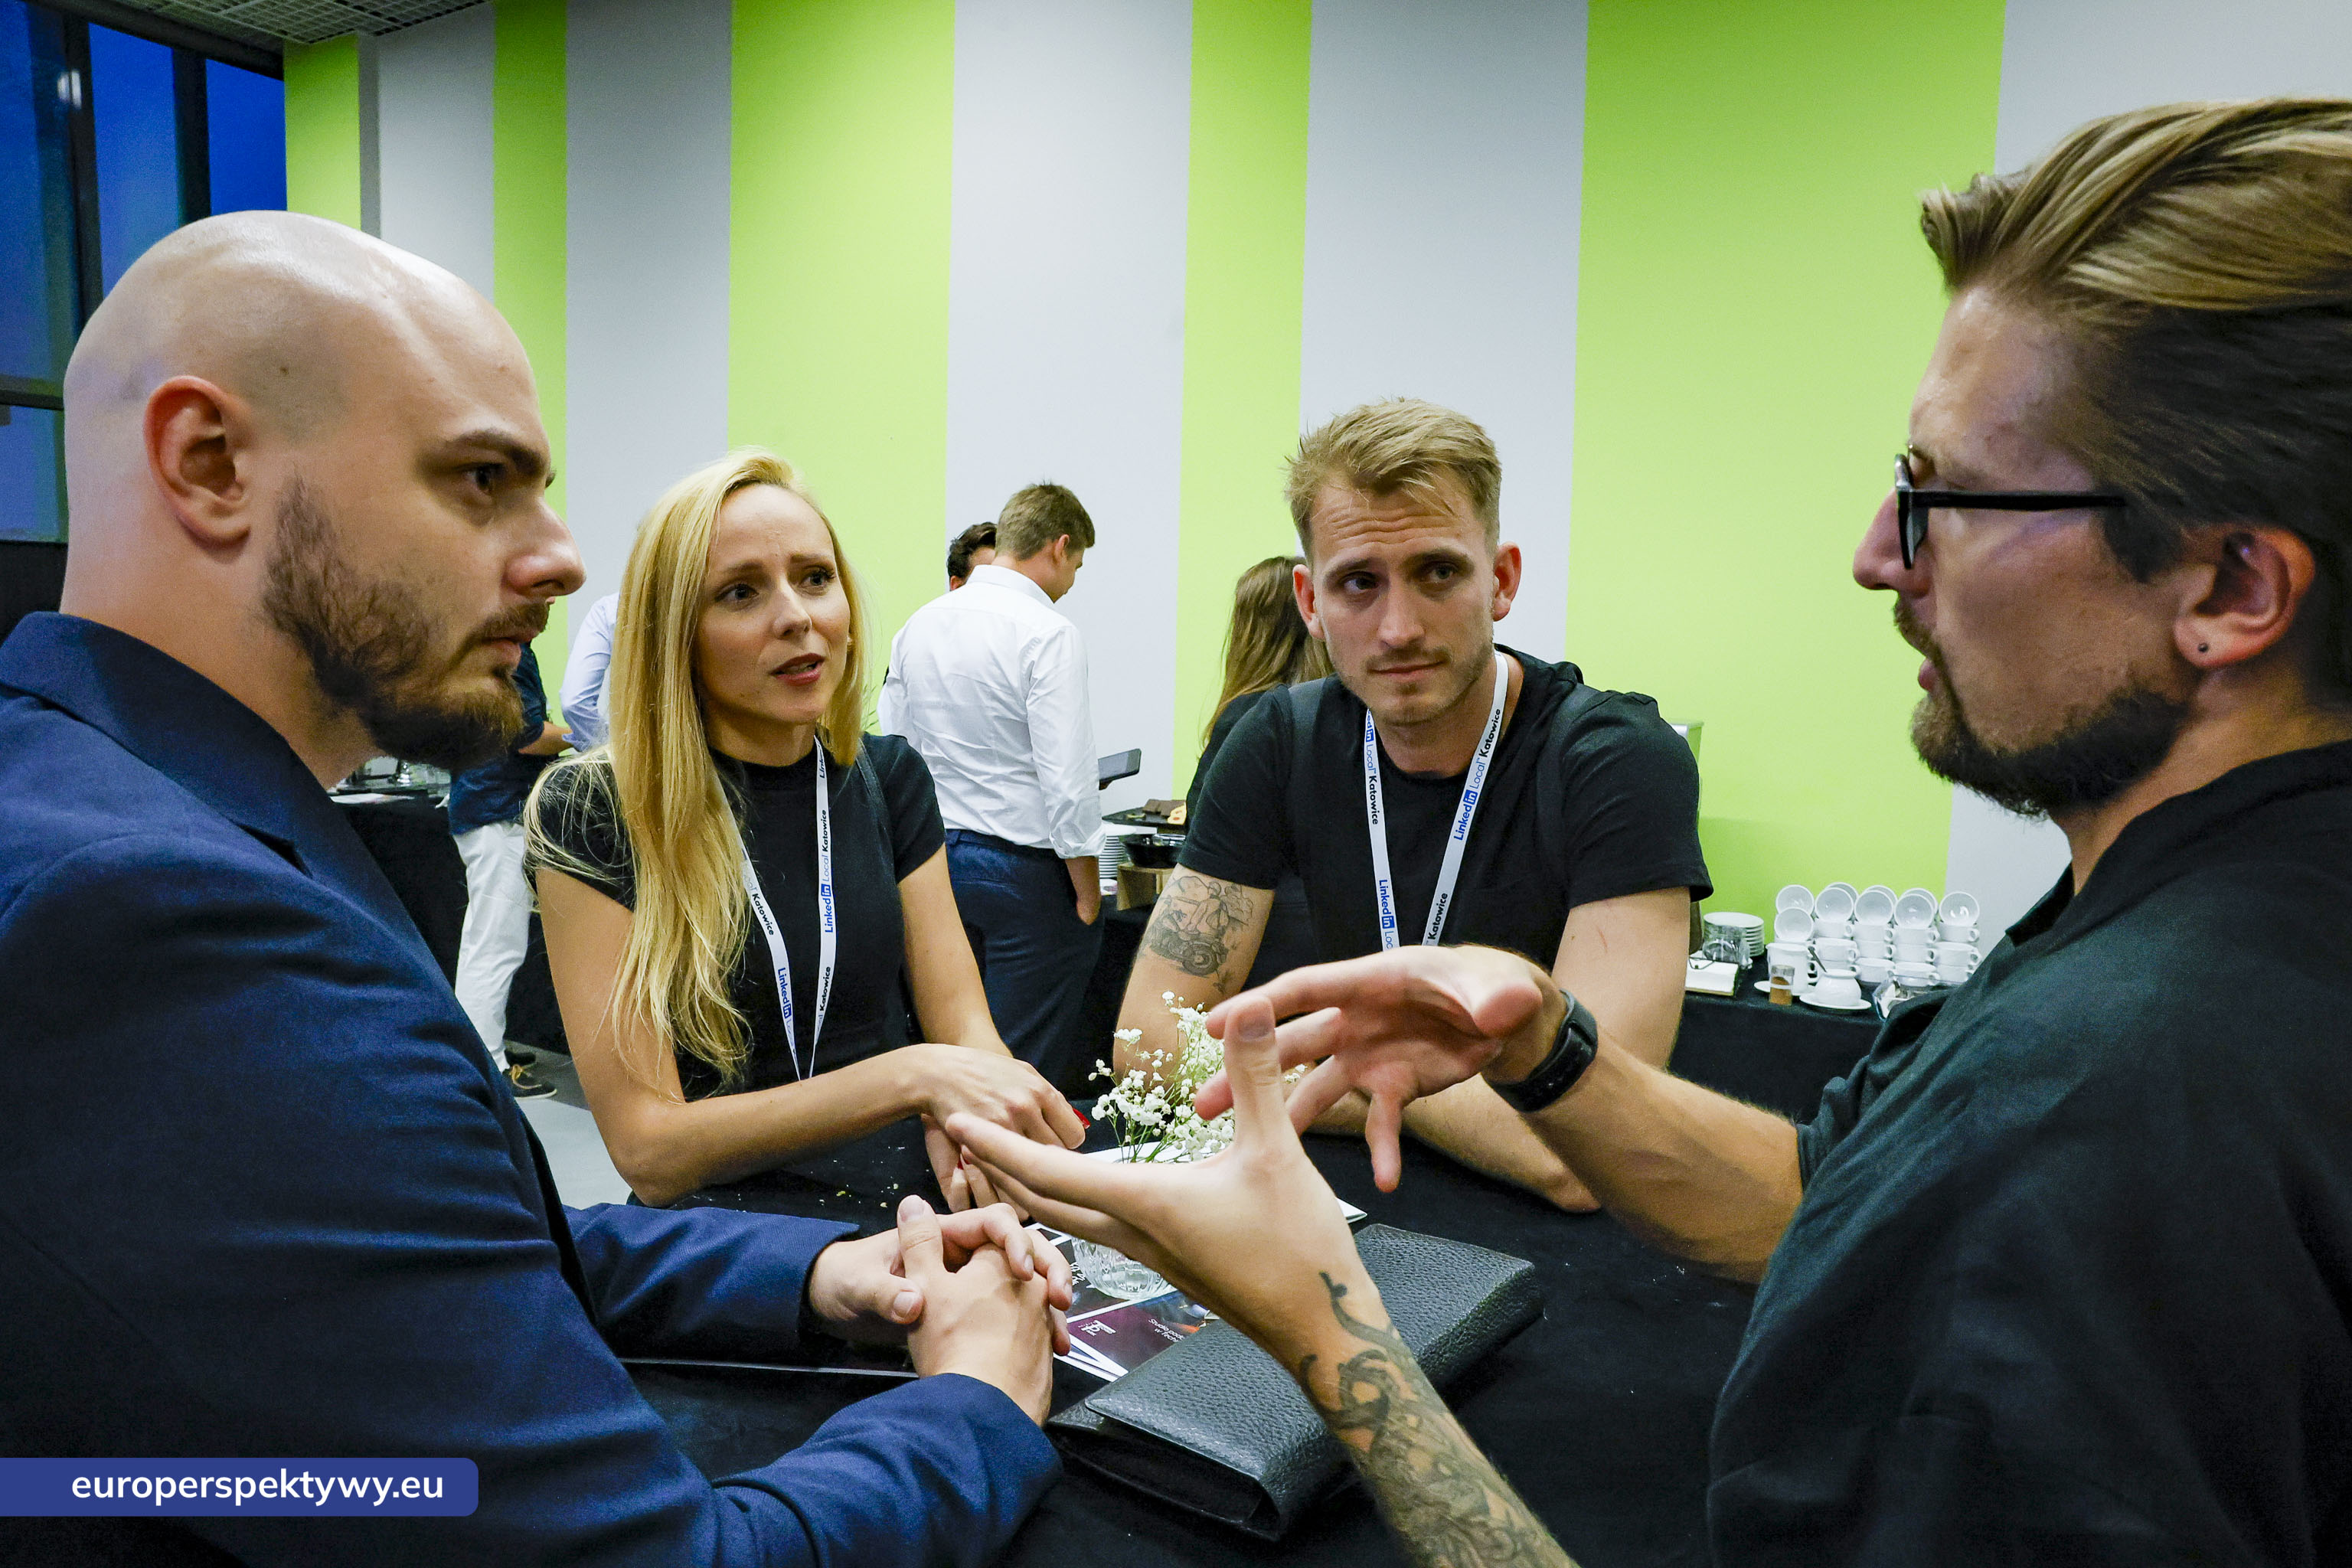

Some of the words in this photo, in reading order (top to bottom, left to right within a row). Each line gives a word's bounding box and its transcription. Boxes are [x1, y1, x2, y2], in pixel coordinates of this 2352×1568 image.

[1478, 708, 1501, 758] Katowice
[1368, 775, 1380, 825] Katowice
[820, 809, 828, 852] Katowice
[752, 893, 774, 936] Katowice
[1427, 893, 1448, 940] Katowice
[1384, 930, 1394, 949] Loc
[819, 966, 831, 1011] Katowice
